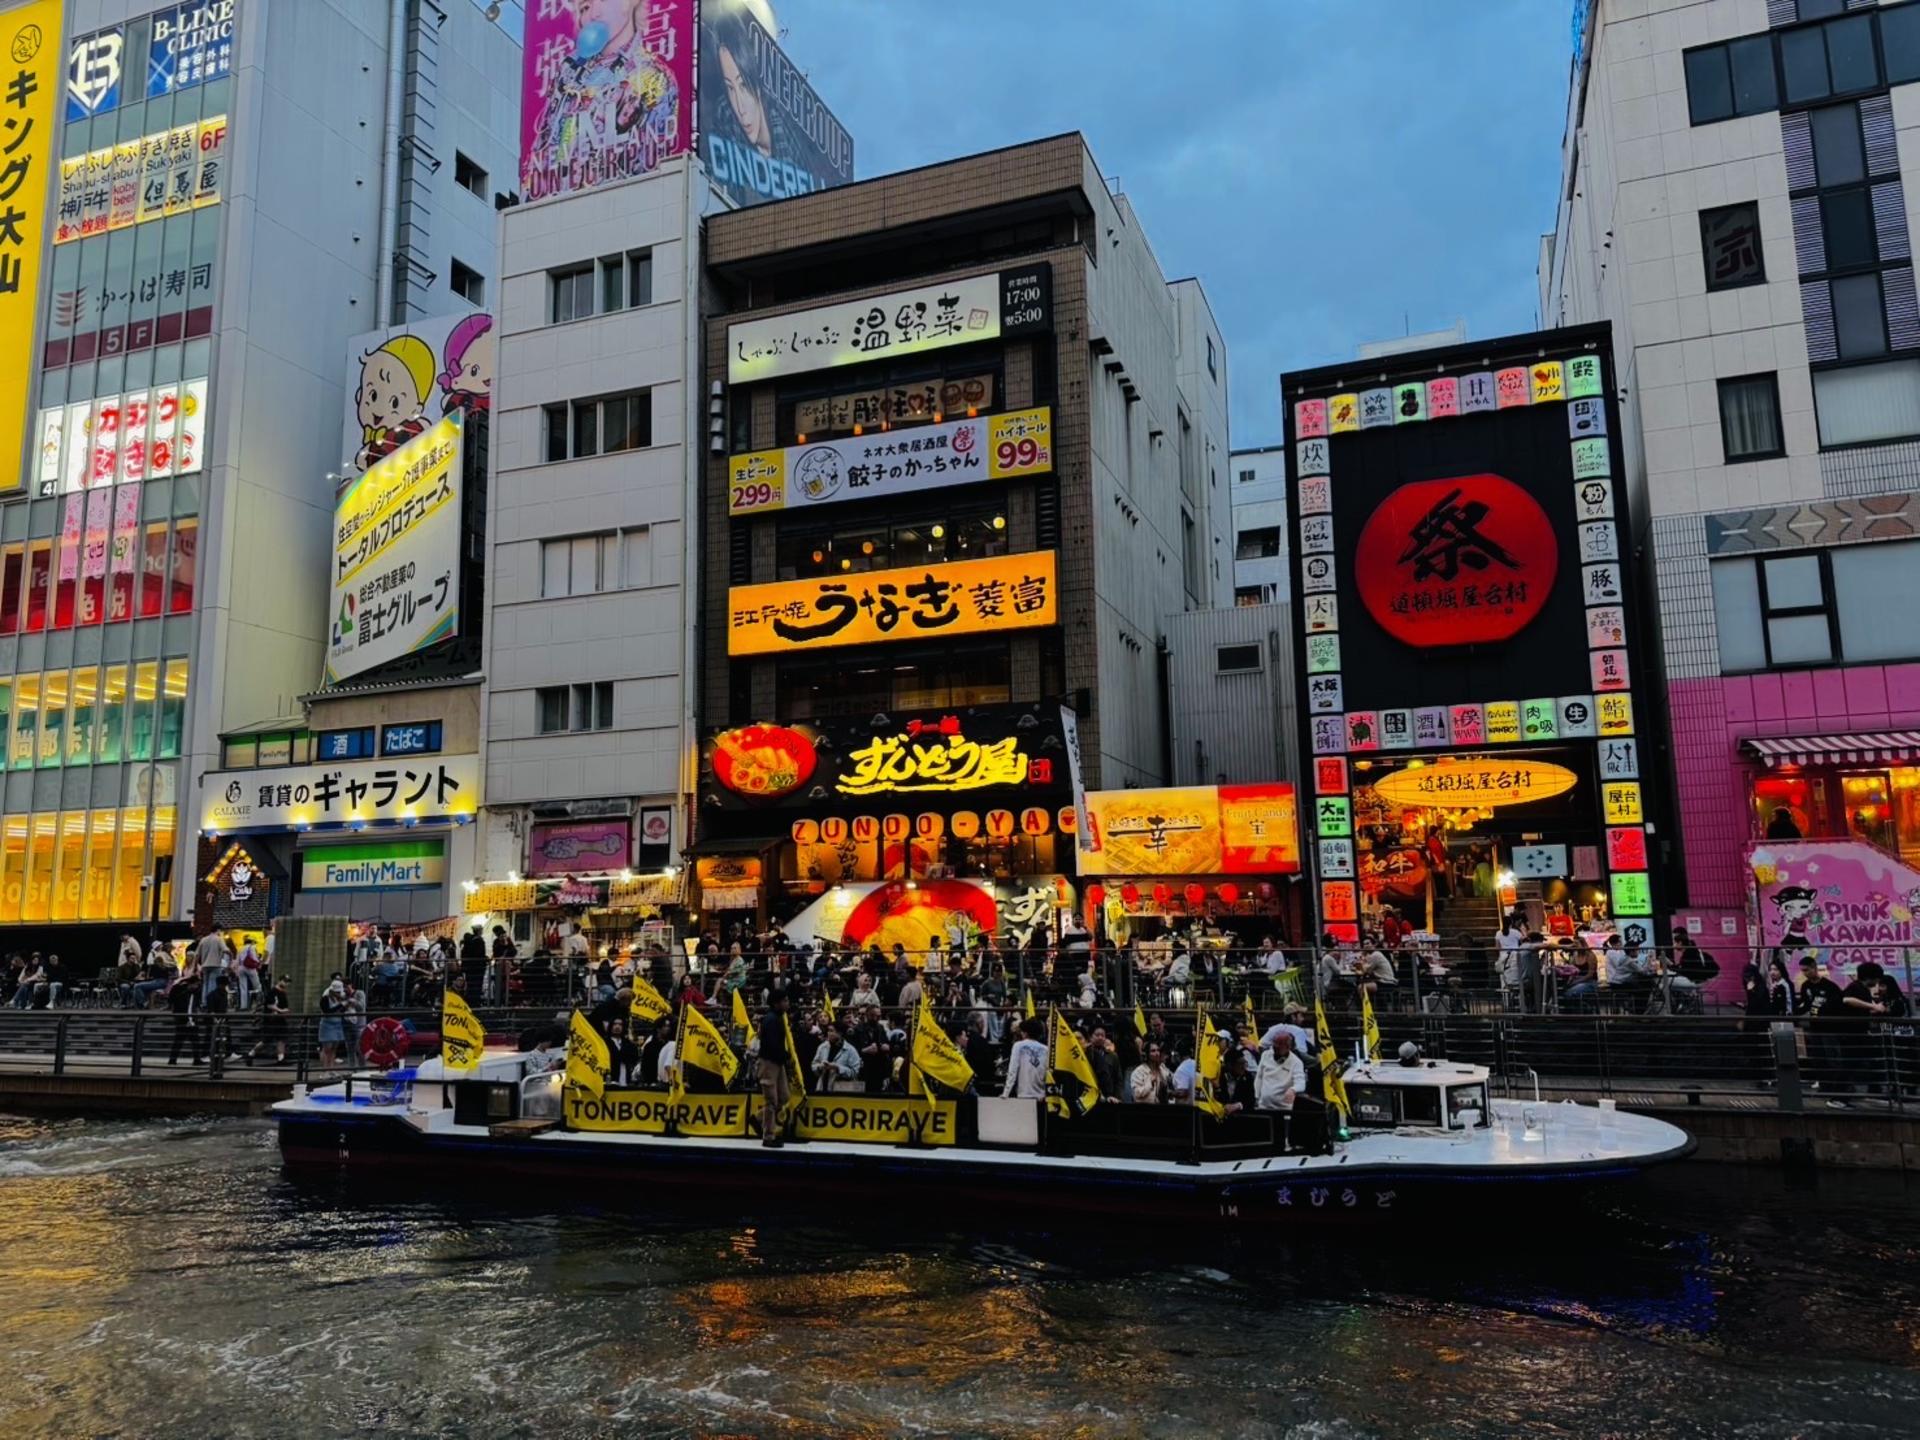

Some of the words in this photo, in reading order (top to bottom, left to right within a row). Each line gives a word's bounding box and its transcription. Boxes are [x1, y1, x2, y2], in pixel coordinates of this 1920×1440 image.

[154, 0, 234, 42] B-LINE
[167, 21, 233, 54] CLINIC
[200, 127, 226, 152] 6F
[62, 167, 133, 195] Shau-sabu
[146, 149, 192, 172] Sukyaki
[708, 134, 827, 199] CINDERE
[1006, 287, 1041, 306] 17:00
[851, 292, 964, 352] 温野菜
[995, 422, 1048, 438] ハイボール
[735, 464, 778, 482] 生ビール
[847, 452, 980, 488] 餃子のかっちゃん
[338, 471, 451, 581] トータルプロデュース
[1590, 568, 1613, 588] 豚
[358, 570, 451, 648] 富士グループ
[773, 572, 964, 643] うなぎ
[968, 574, 1047, 620] 菱富
[1312, 679, 1338, 693] 大阪
[1416, 714, 1435, 730] 酒
[1526, 705, 1541, 720] 肉
[1539, 719, 1555, 733] 吸
[332, 734, 348, 756] 酒
[386, 728, 425, 752] たばこ
[836, 733, 1029, 795] ずんどう屋
[1417, 770, 1533, 793] 道頓堀屋台村
[326, 861, 422, 884] FamilyMart
[1824, 900, 1890, 922] PINK
[1817, 920, 1911, 944] KAWAII
[1831, 948, 1897, 967] CAFE
